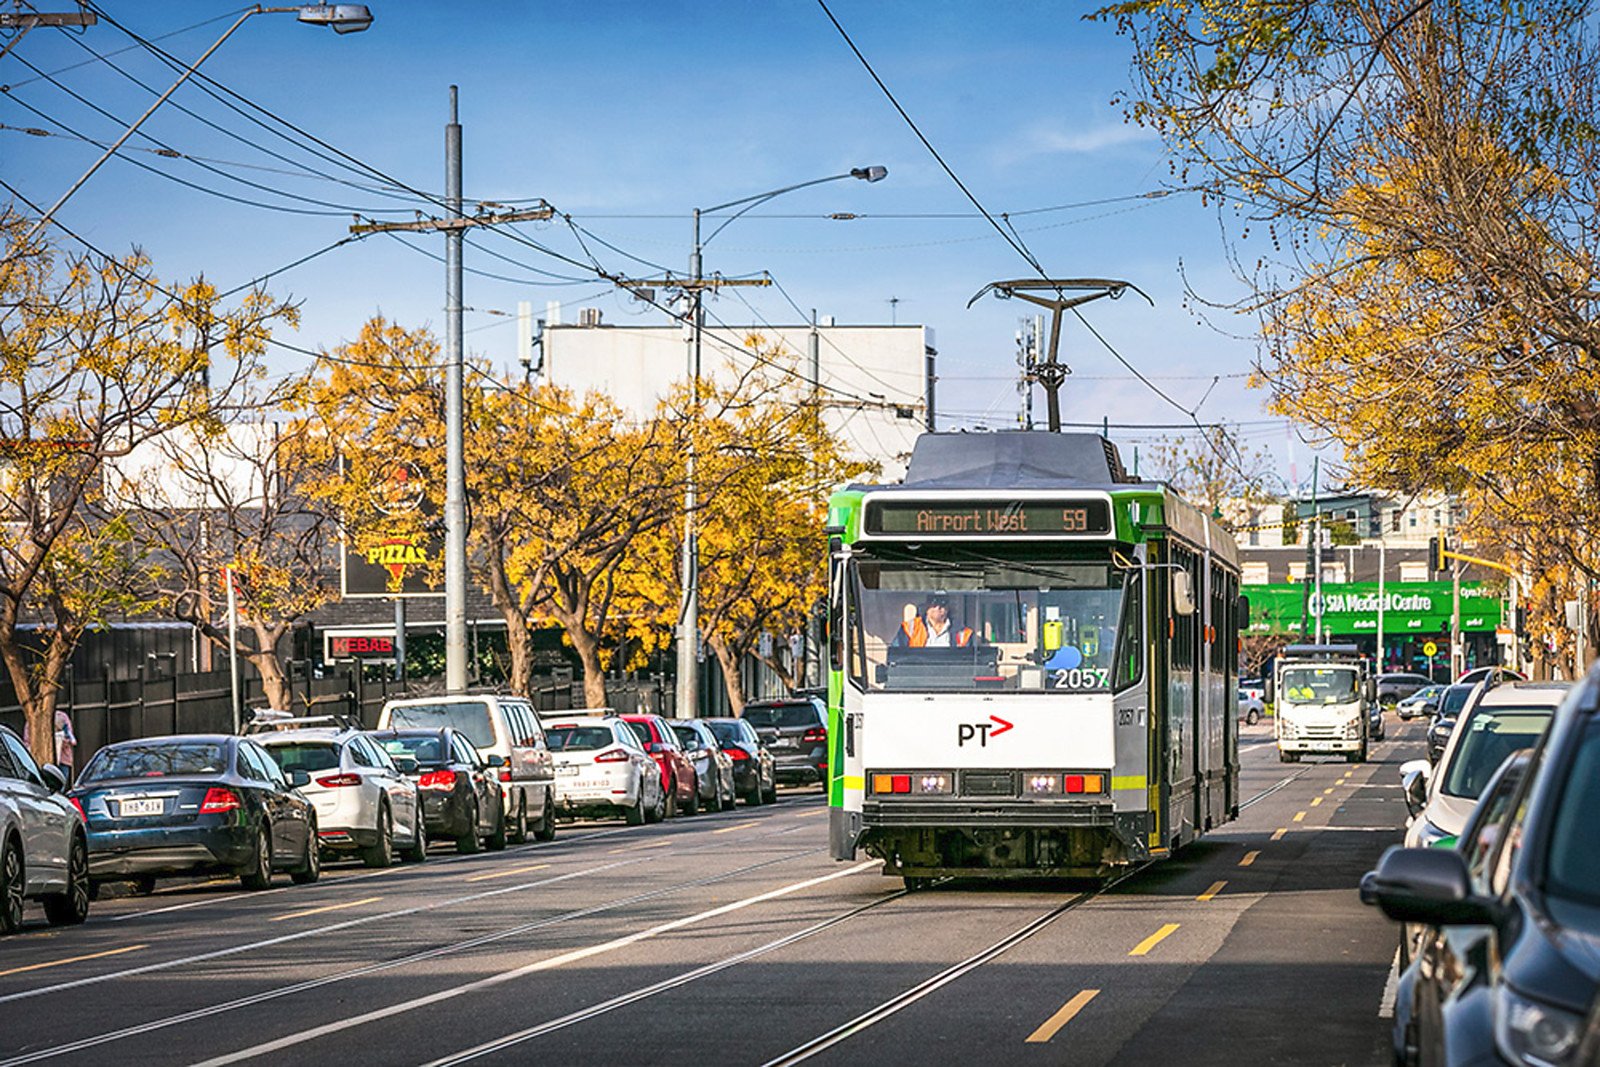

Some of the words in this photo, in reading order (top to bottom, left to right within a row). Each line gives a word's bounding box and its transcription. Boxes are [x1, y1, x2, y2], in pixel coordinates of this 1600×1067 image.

[917, 510, 982, 531] Airport
[987, 510, 1027, 531] West
[1062, 509, 1087, 531] 59
[368, 544, 427, 565] PIZZAS
[1392, 593, 1431, 611] Centre
[333, 637, 392, 652] KEBAB
[1055, 668, 1109, 689] 2057
